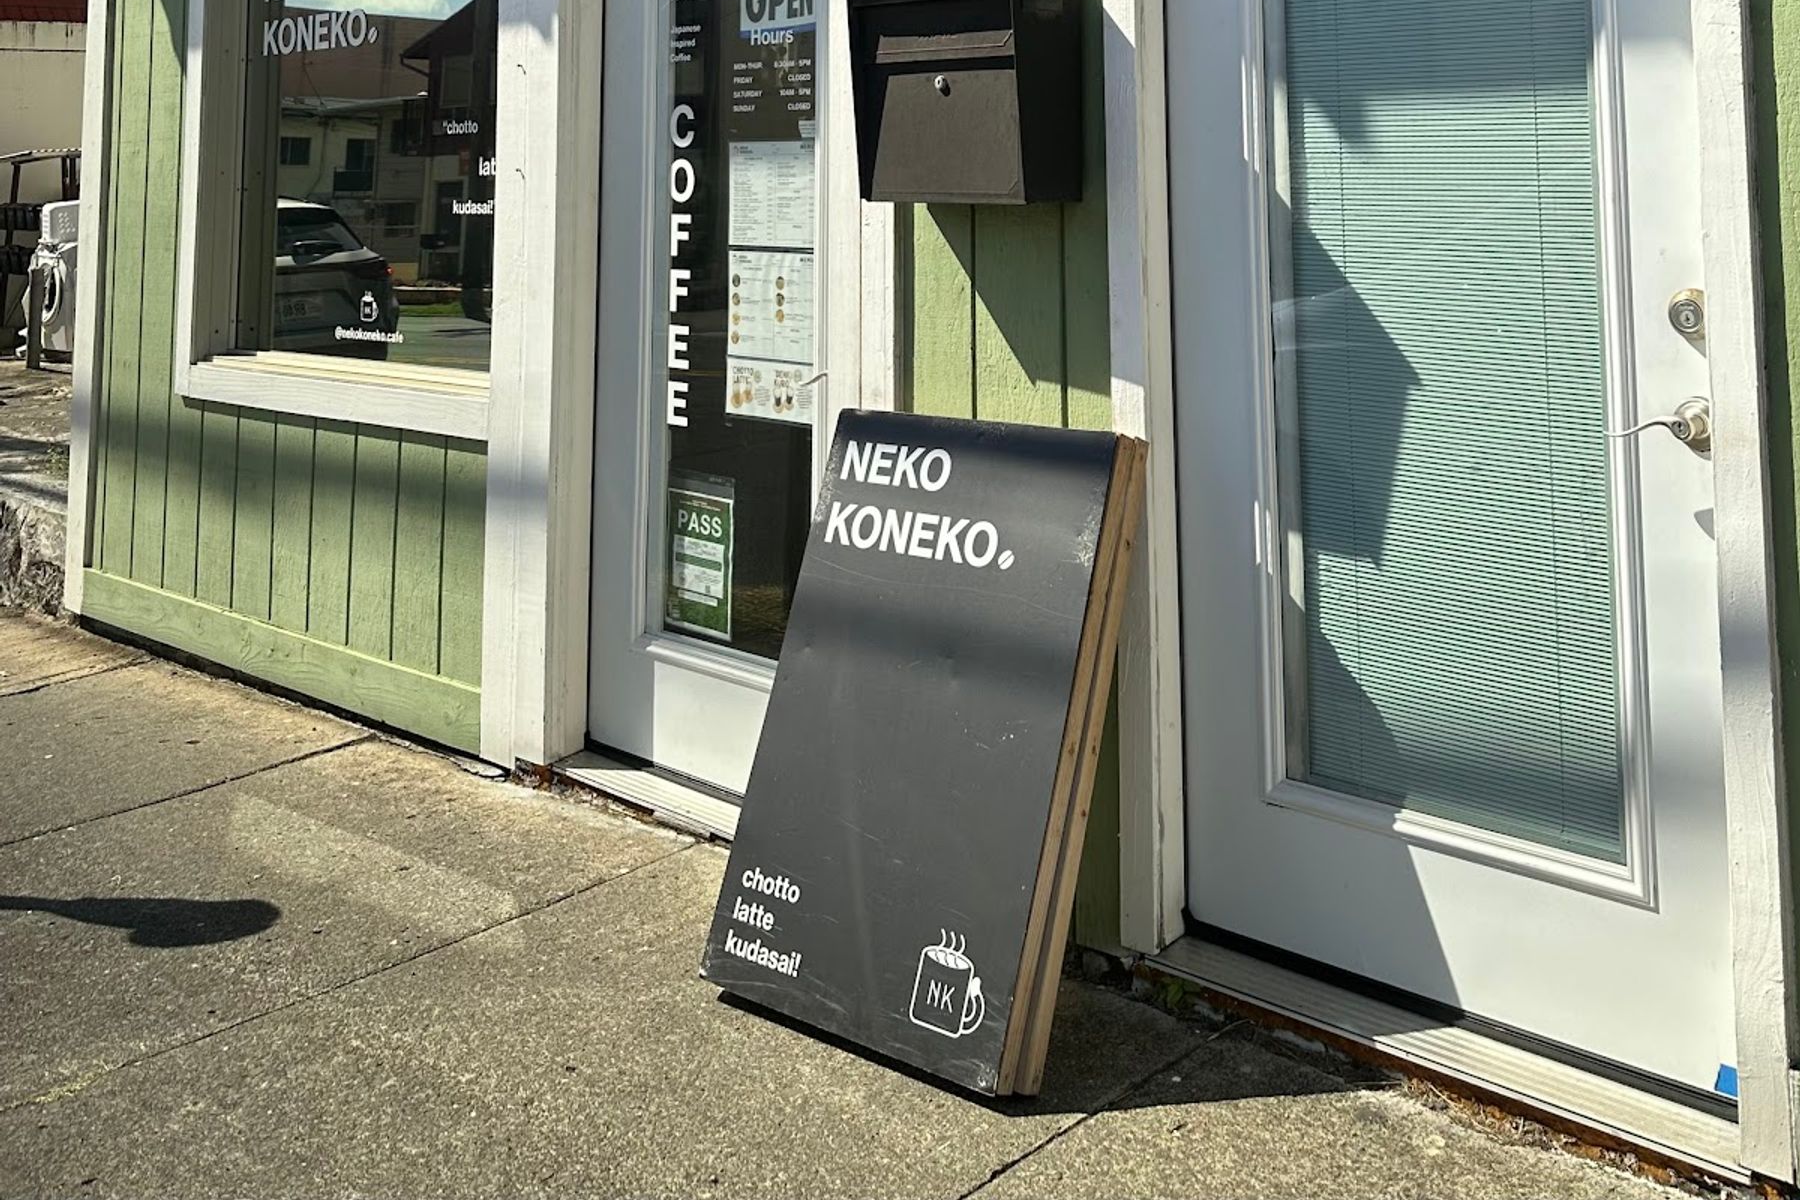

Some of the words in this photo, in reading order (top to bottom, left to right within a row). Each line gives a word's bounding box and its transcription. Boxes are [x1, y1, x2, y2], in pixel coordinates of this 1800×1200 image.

[670, 24, 701, 35] Japanese
[750, 27, 794, 46] Hours
[732, 90, 763, 99] SATURDAY
[733, 76, 753, 84] FRIDAY
[787, 73, 811, 82] CLOSED
[732, 104, 755, 113] SUNDAY
[787, 102, 811, 111] CLOSED
[667, 103, 696, 427] COFFEE
[840, 439, 953, 492] NEKO
[677, 509, 723, 538] PASS
[742, 866, 801, 904] chotto
[732, 895, 775, 931] latte
[724, 928, 802, 978] kudasai!
[926, 978, 956, 1014] NK
